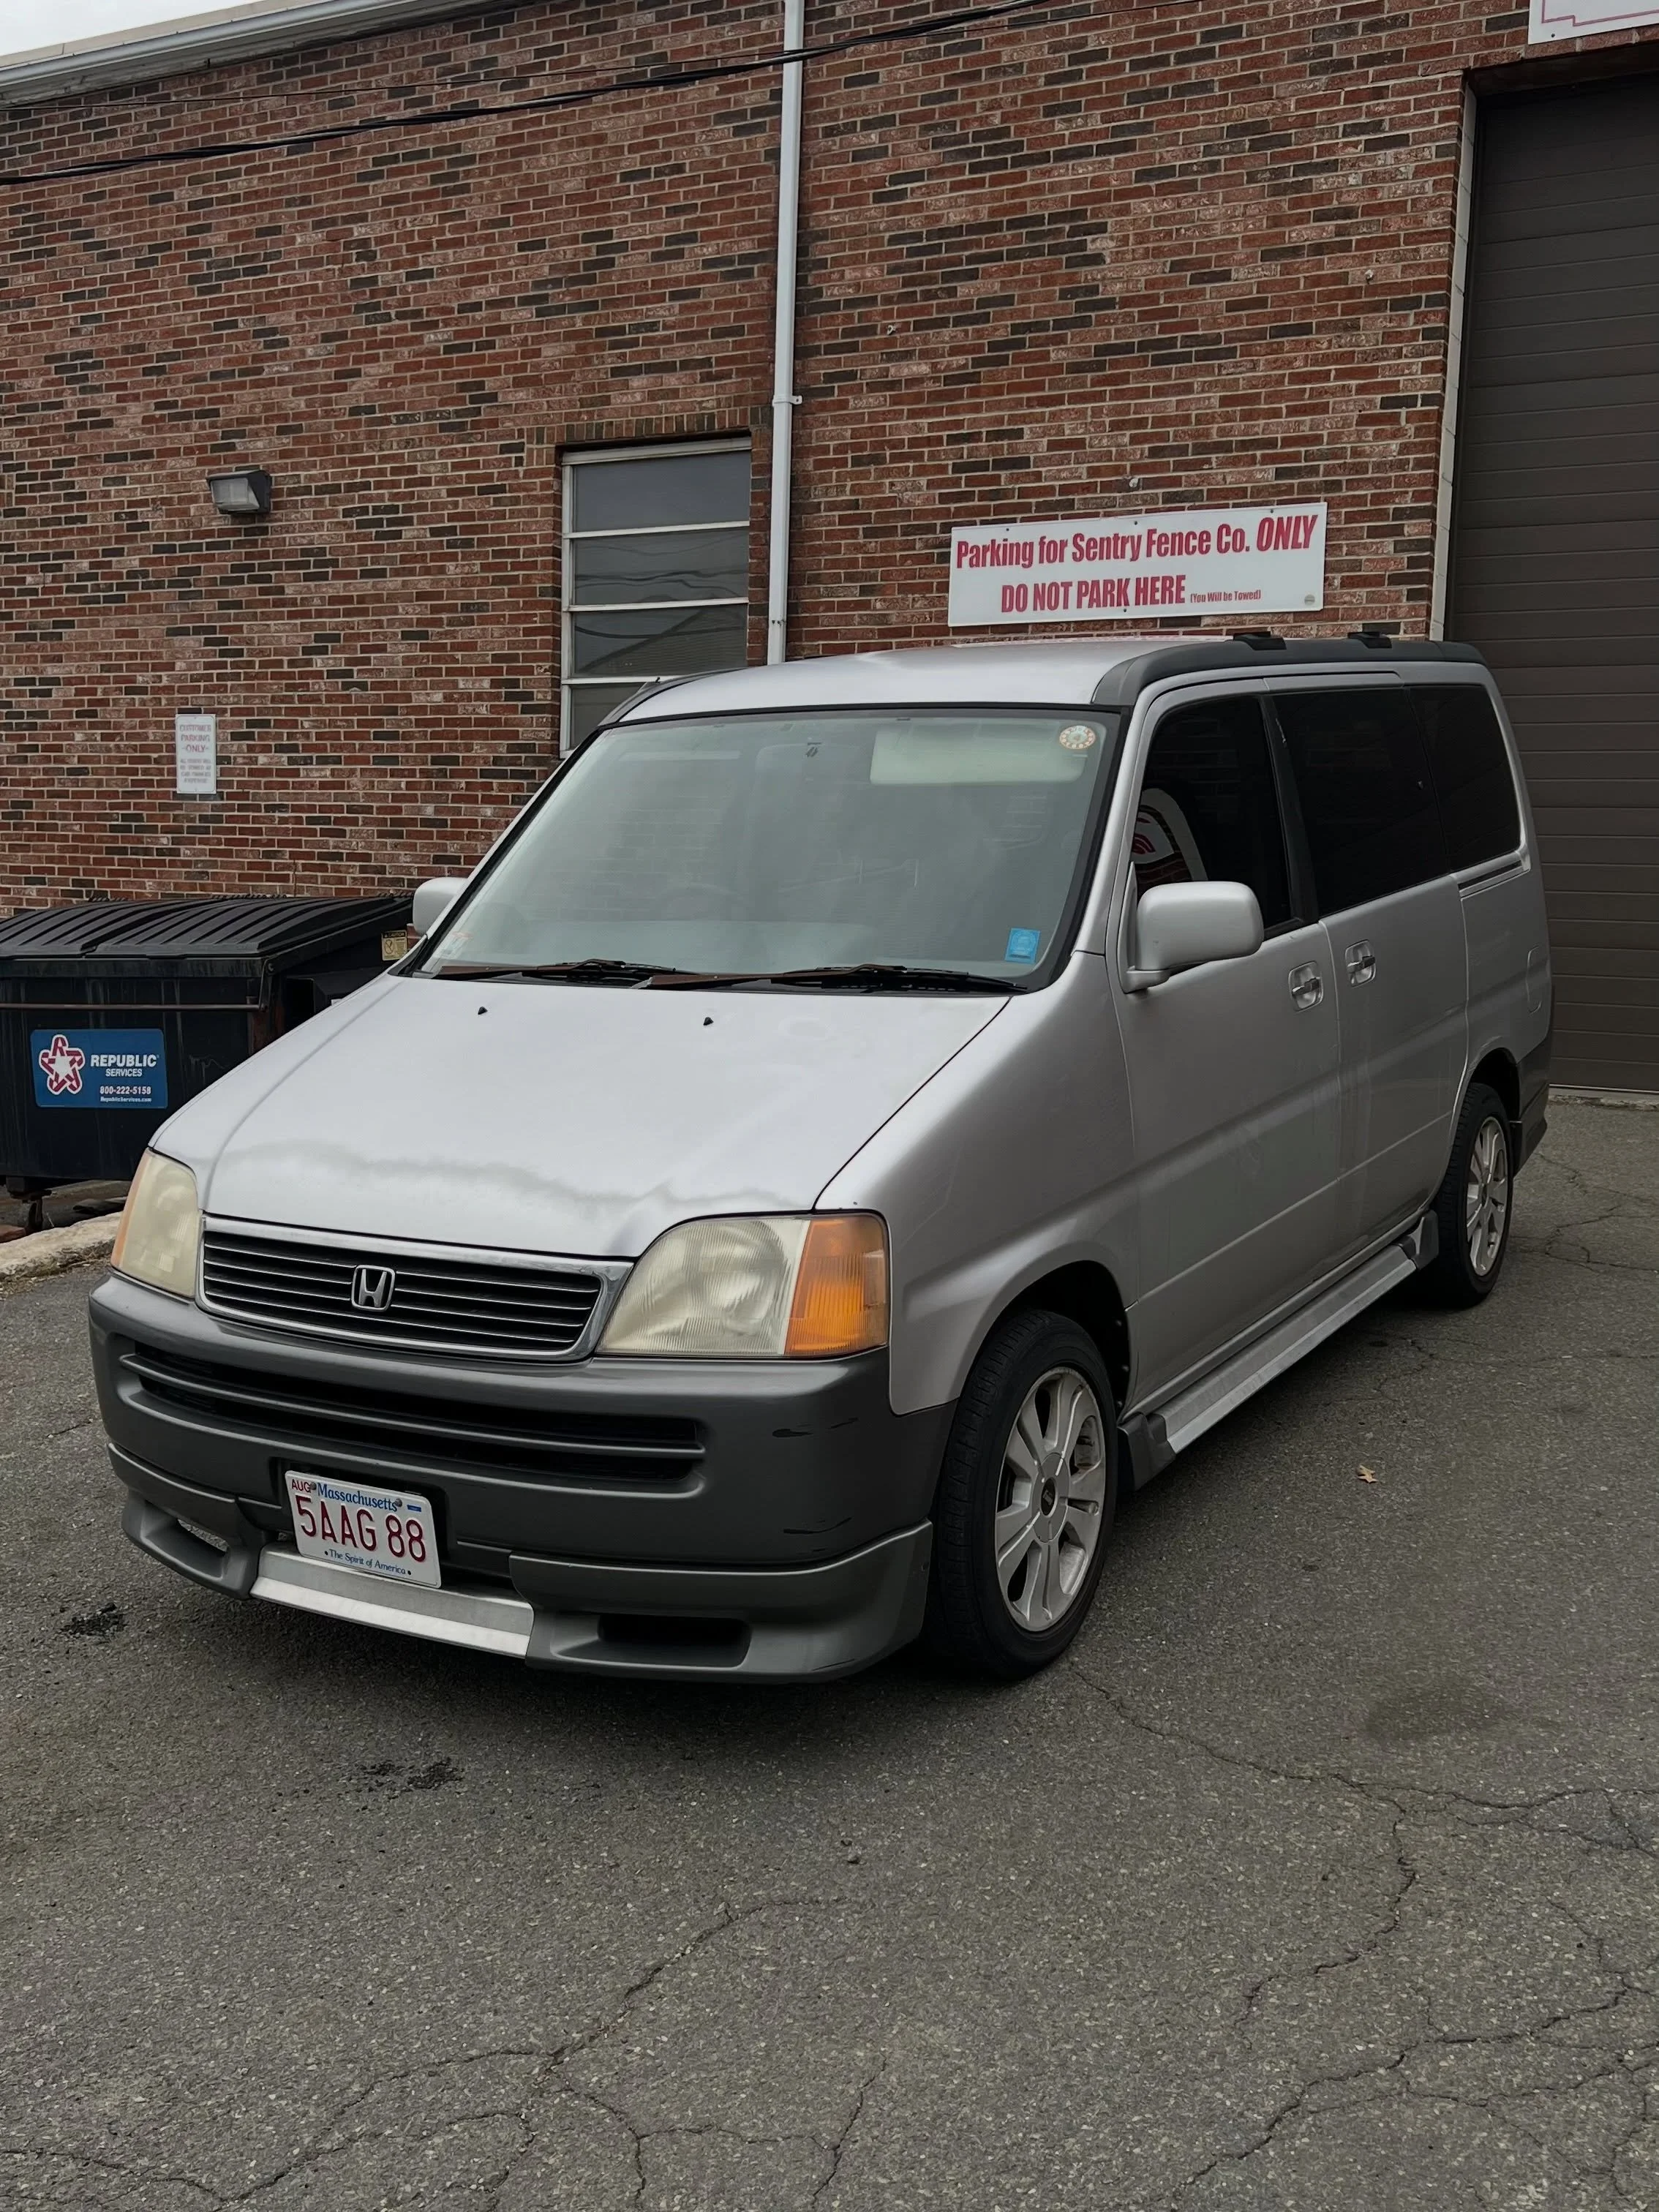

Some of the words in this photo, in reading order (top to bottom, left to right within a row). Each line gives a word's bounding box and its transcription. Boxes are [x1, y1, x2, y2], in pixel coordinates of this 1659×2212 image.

[956, 538, 1034, 569] Parking
[1039, 535, 1069, 565] for
[1072, 533, 1142, 562] Sentry
[1146, 528, 1211, 558] Fence
[1216, 523, 1250, 554] Co.
[1257, 514, 1319, 552] ONLY
[1001, 584, 1028, 613] DO
[1033, 581, 1073, 612] NOT
[1076, 577, 1131, 609] PARK
[1135, 574, 1186, 606] HERE
[1190, 592, 1206, 603] (You
[1207, 592, 1222, 602] Will
[1224, 591, 1233, 601] be
[1234, 589, 1261, 601] Towed)
[181, 734, 210, 742] PARKING
[91, 1055, 157, 1067] REPUBLIC
[105, 1069, 142, 1077] SERVICES
[99, 1086, 151, 1094] 800-222-5158
[292, 1478, 312, 1494] AUG
[317, 1483, 398, 1513] Massachusetts
[295, 1494, 378, 1552] 5AAG
[385, 1514, 426, 1563] 88
[329, 1549, 343, 1560] The
[345, 1552, 364, 1565] Spirit
[366, 1559, 374, 1568] of
[375, 1560, 406, 1576] America
